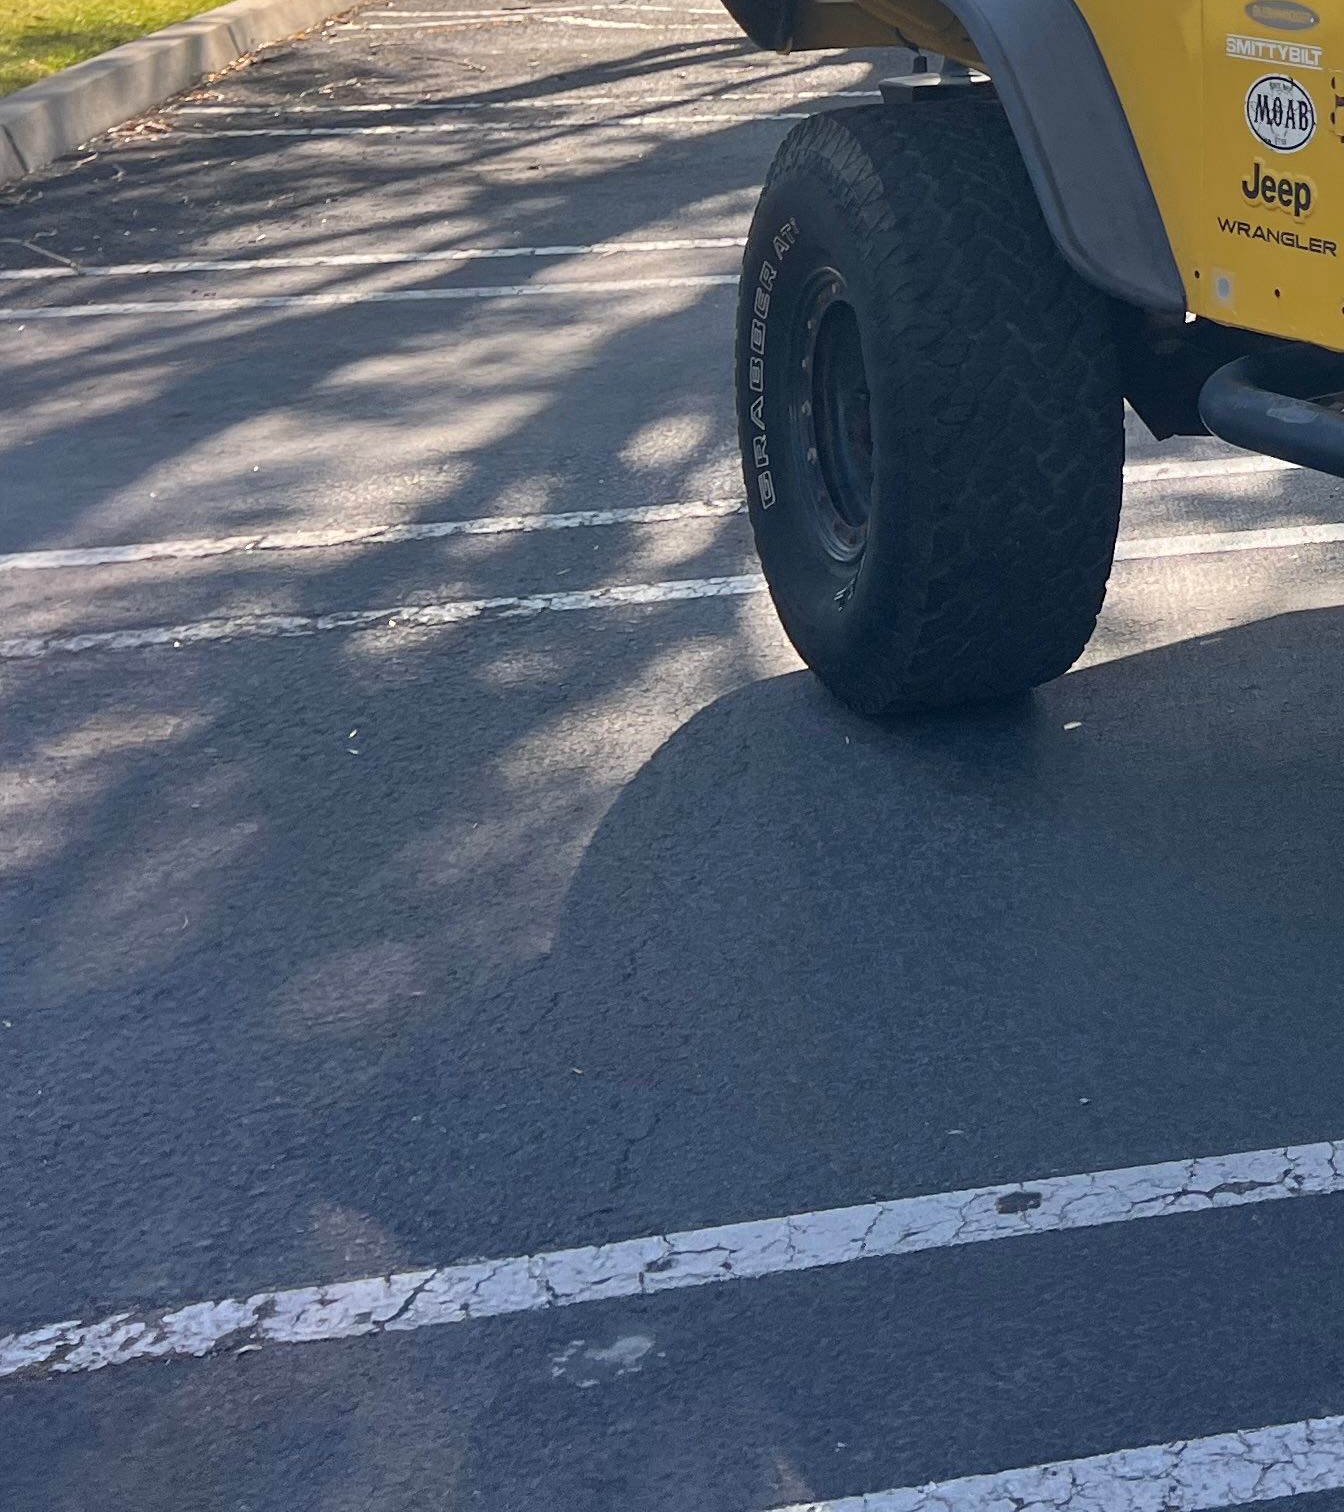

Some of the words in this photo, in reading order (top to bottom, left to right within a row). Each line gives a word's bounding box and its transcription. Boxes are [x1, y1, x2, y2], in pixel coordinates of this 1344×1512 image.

[1225, 37, 1323, 66] SMITTYBILT
[1254, 94, 1309, 131] MOAB
[1242, 162, 1311, 217] Jeep
[1217, 216, 1337, 257] WRANGLER
[748, 260, 777, 510] GRABBER
